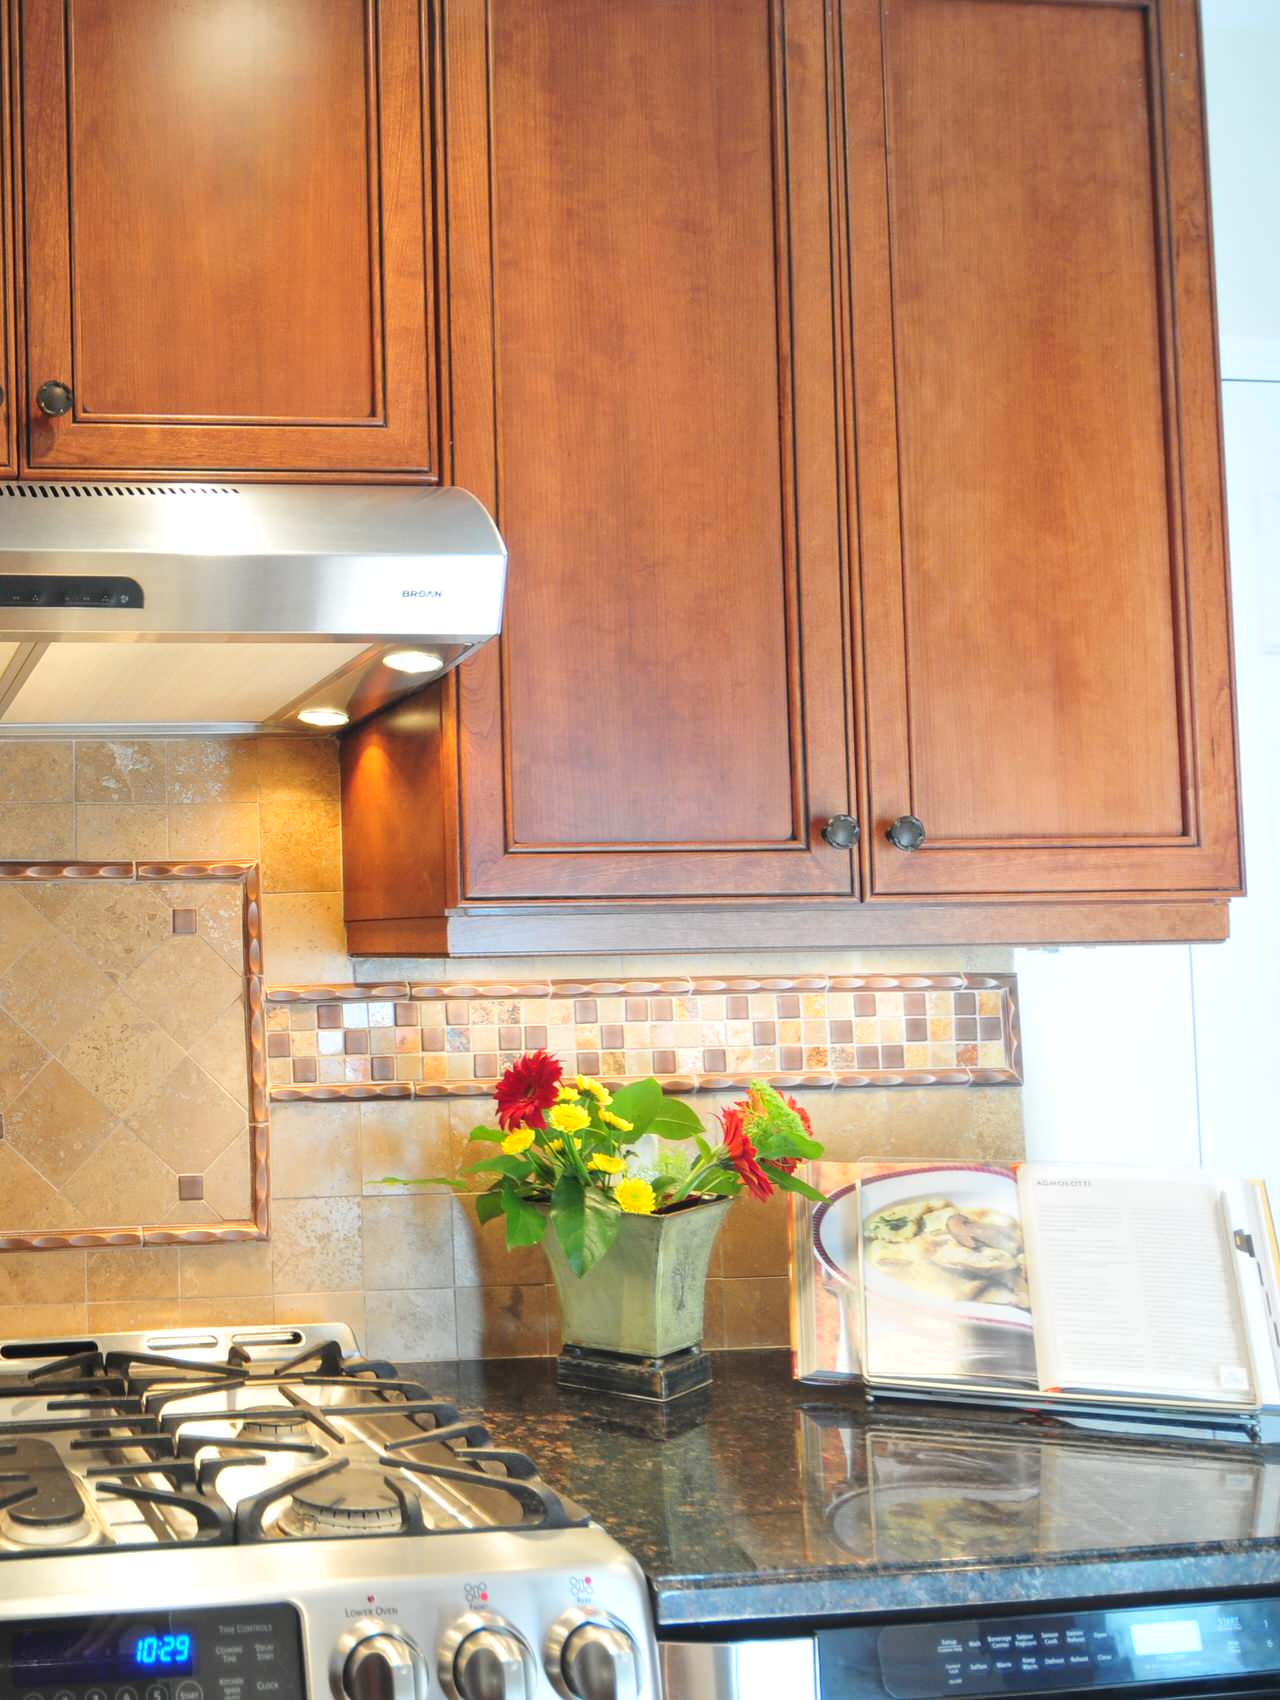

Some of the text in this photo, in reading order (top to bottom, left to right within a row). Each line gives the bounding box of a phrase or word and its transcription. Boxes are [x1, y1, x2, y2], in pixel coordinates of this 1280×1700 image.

[401, 589, 442, 598] BROAN
[344, 1605, 399, 1618] LOWER OVEN
[136, 1634, 191, 1664] 10:29
